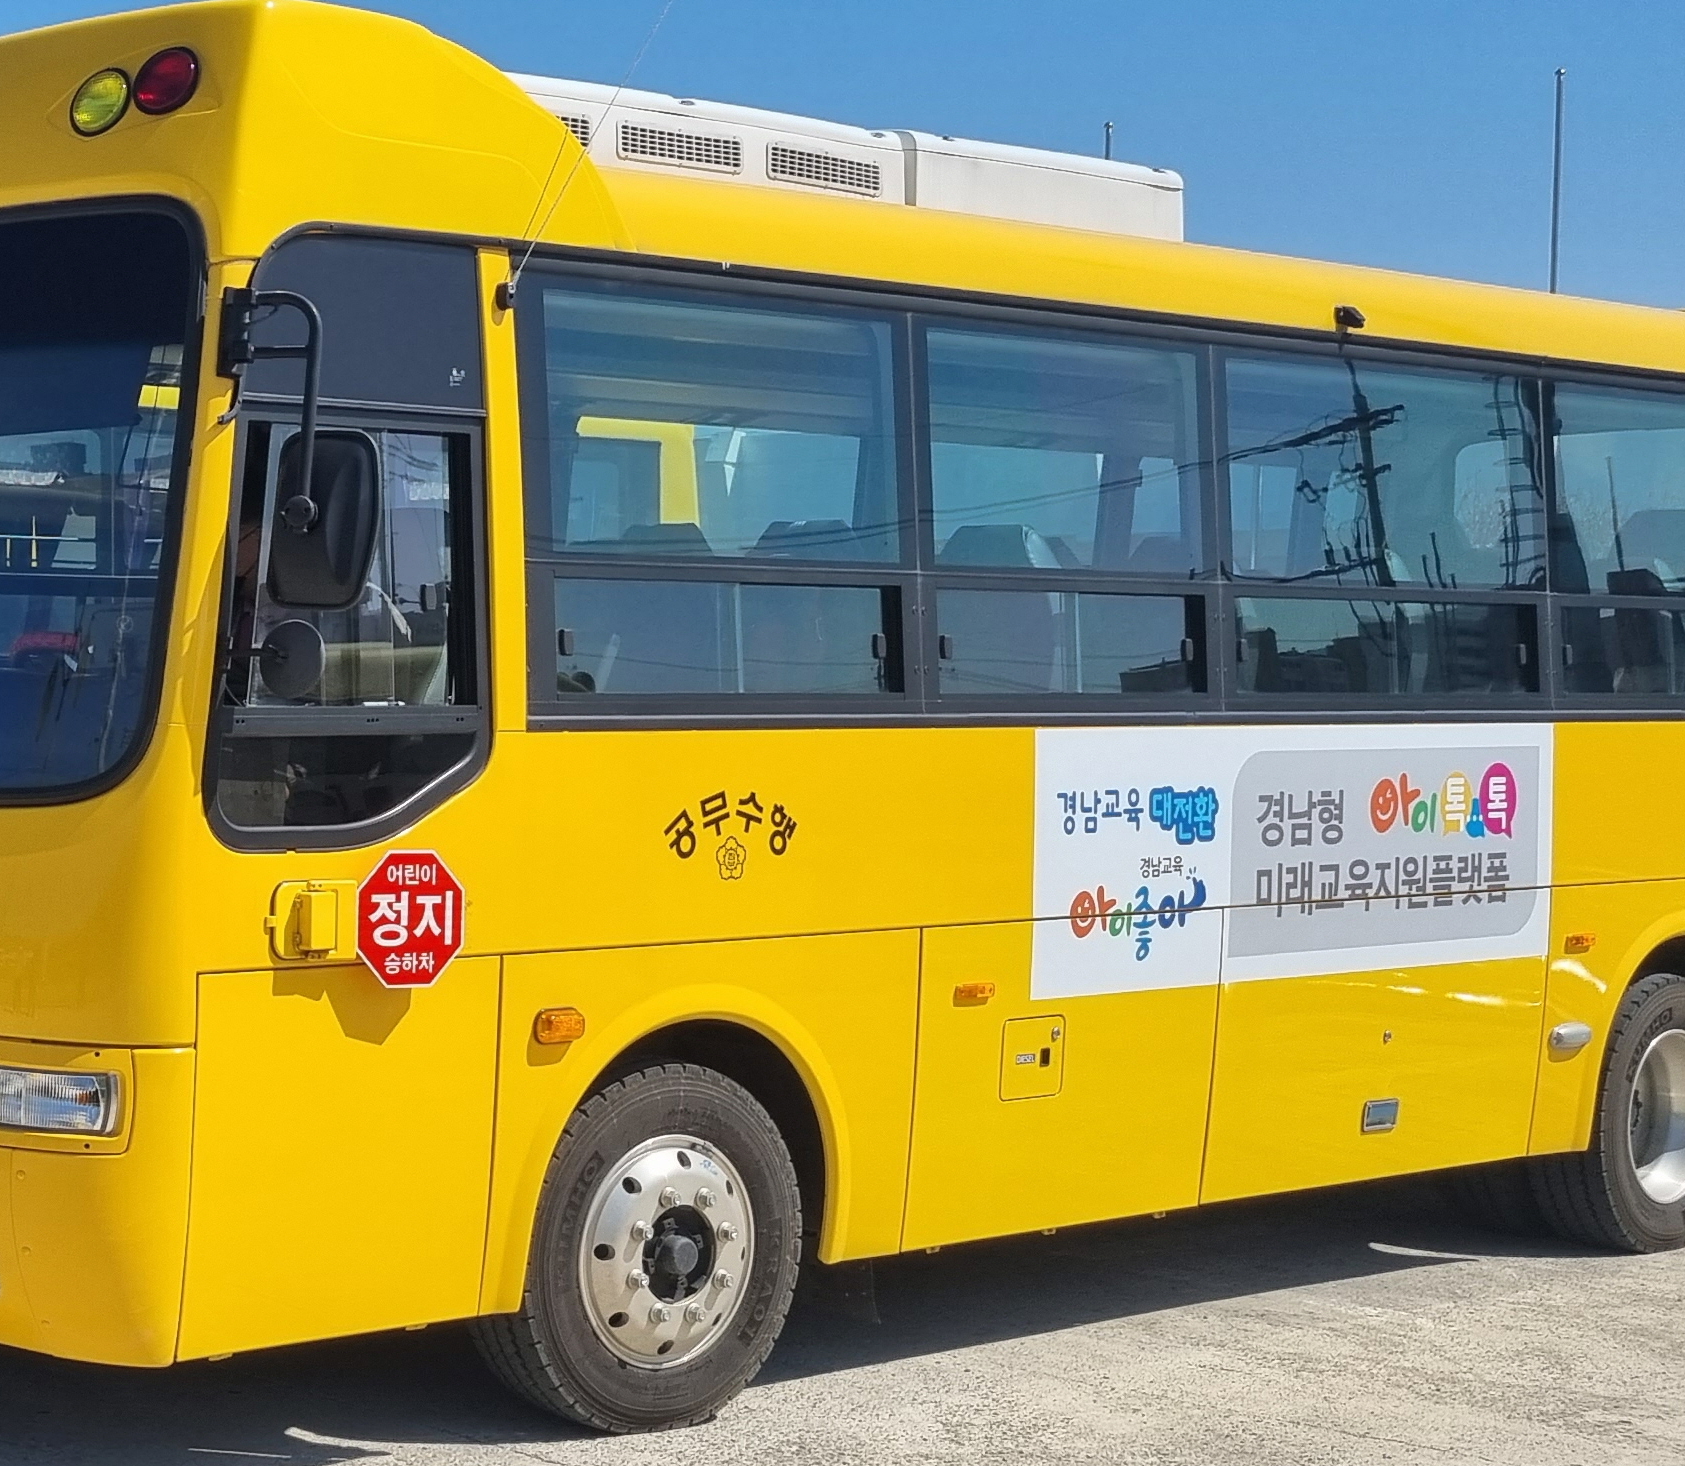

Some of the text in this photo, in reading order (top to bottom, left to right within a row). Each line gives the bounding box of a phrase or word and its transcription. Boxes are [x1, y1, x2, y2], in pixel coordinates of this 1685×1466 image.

[663, 790, 798, 860] 공무수행
[1056, 788, 1218, 844] 경남교육 대전환
[1255, 788, 1345, 848] 경남형
[386, 863, 437, 886] 어린이
[1139, 855, 1184, 879] 경남교육
[1255, 851, 1510, 918] 미래교육지원플랫폼
[368, 890, 454, 948] 정지
[1069, 876, 1208, 962] 아이좋아
[383, 951, 435, 975] 승하차
